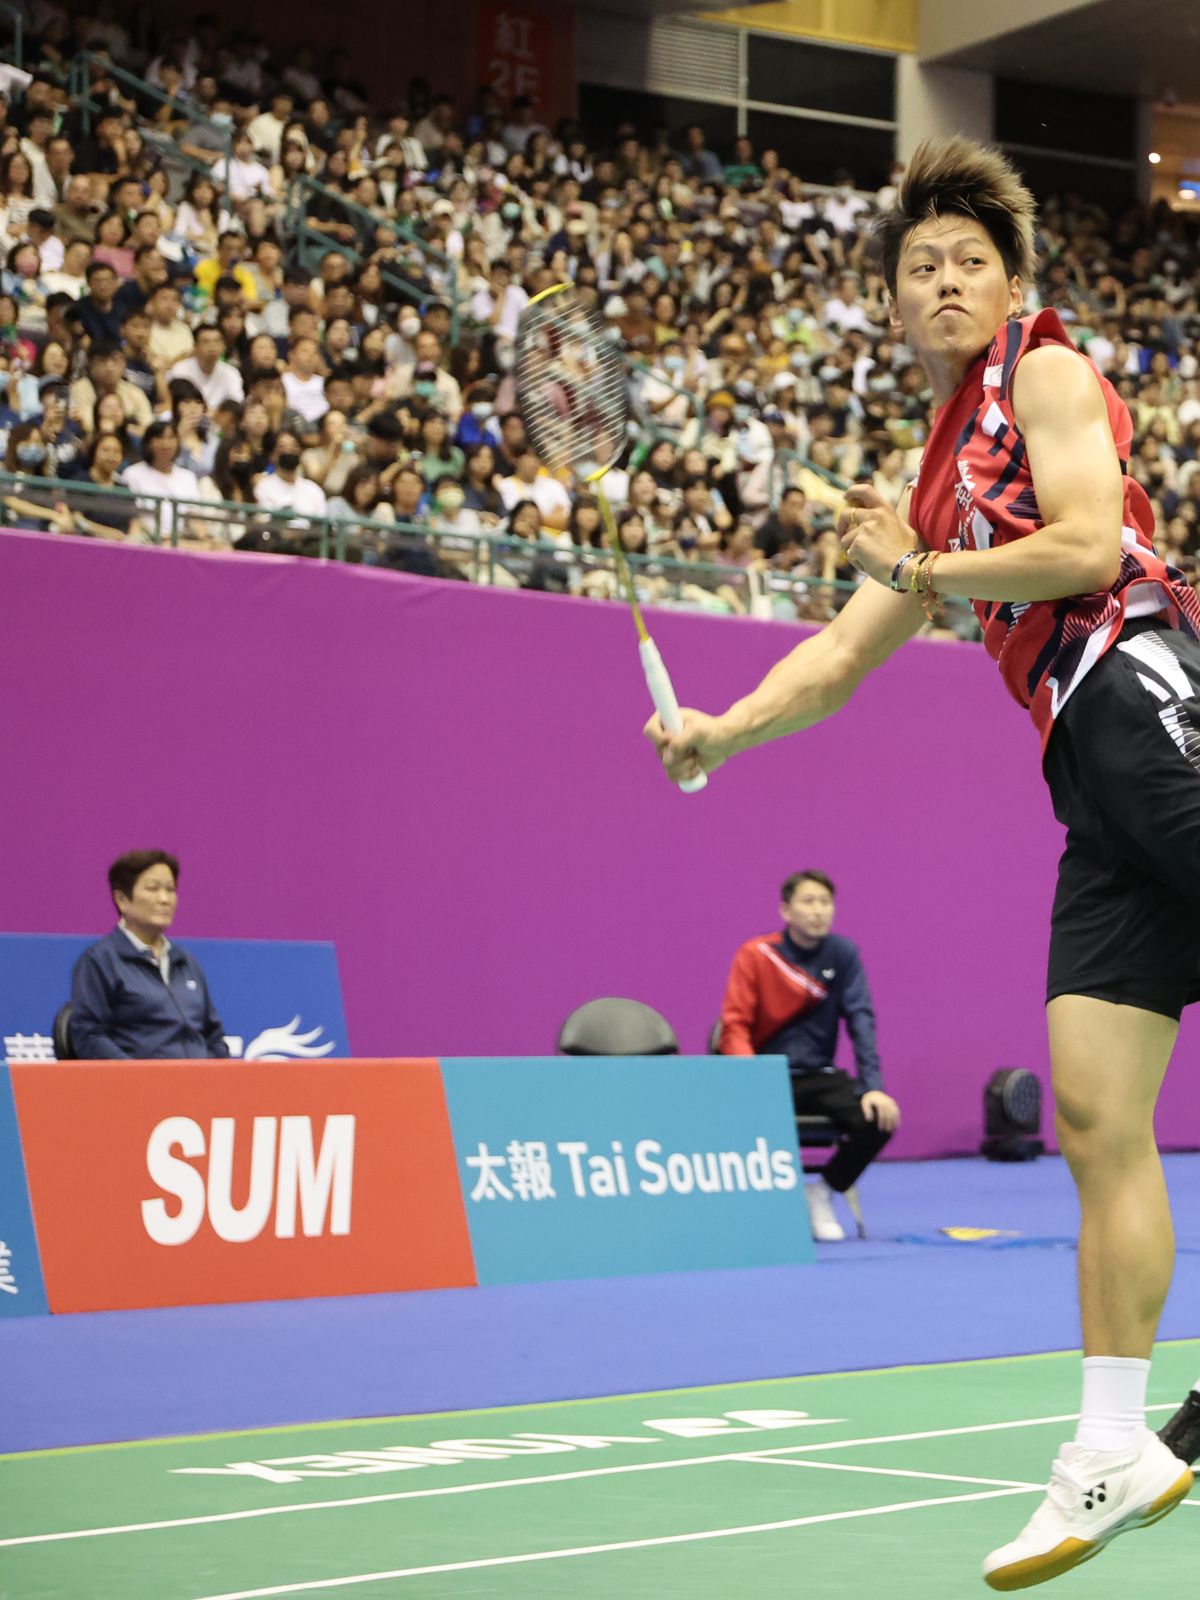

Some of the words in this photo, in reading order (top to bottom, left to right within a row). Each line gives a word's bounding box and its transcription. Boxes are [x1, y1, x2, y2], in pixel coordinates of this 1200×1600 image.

[141, 1114, 356, 1247] SUM
[465, 1139, 556, 1202] 太報
[556, 1140, 631, 1198] Tai
[634, 1136, 798, 1196] Sounds
[167, 1432, 663, 1484] YONEX
